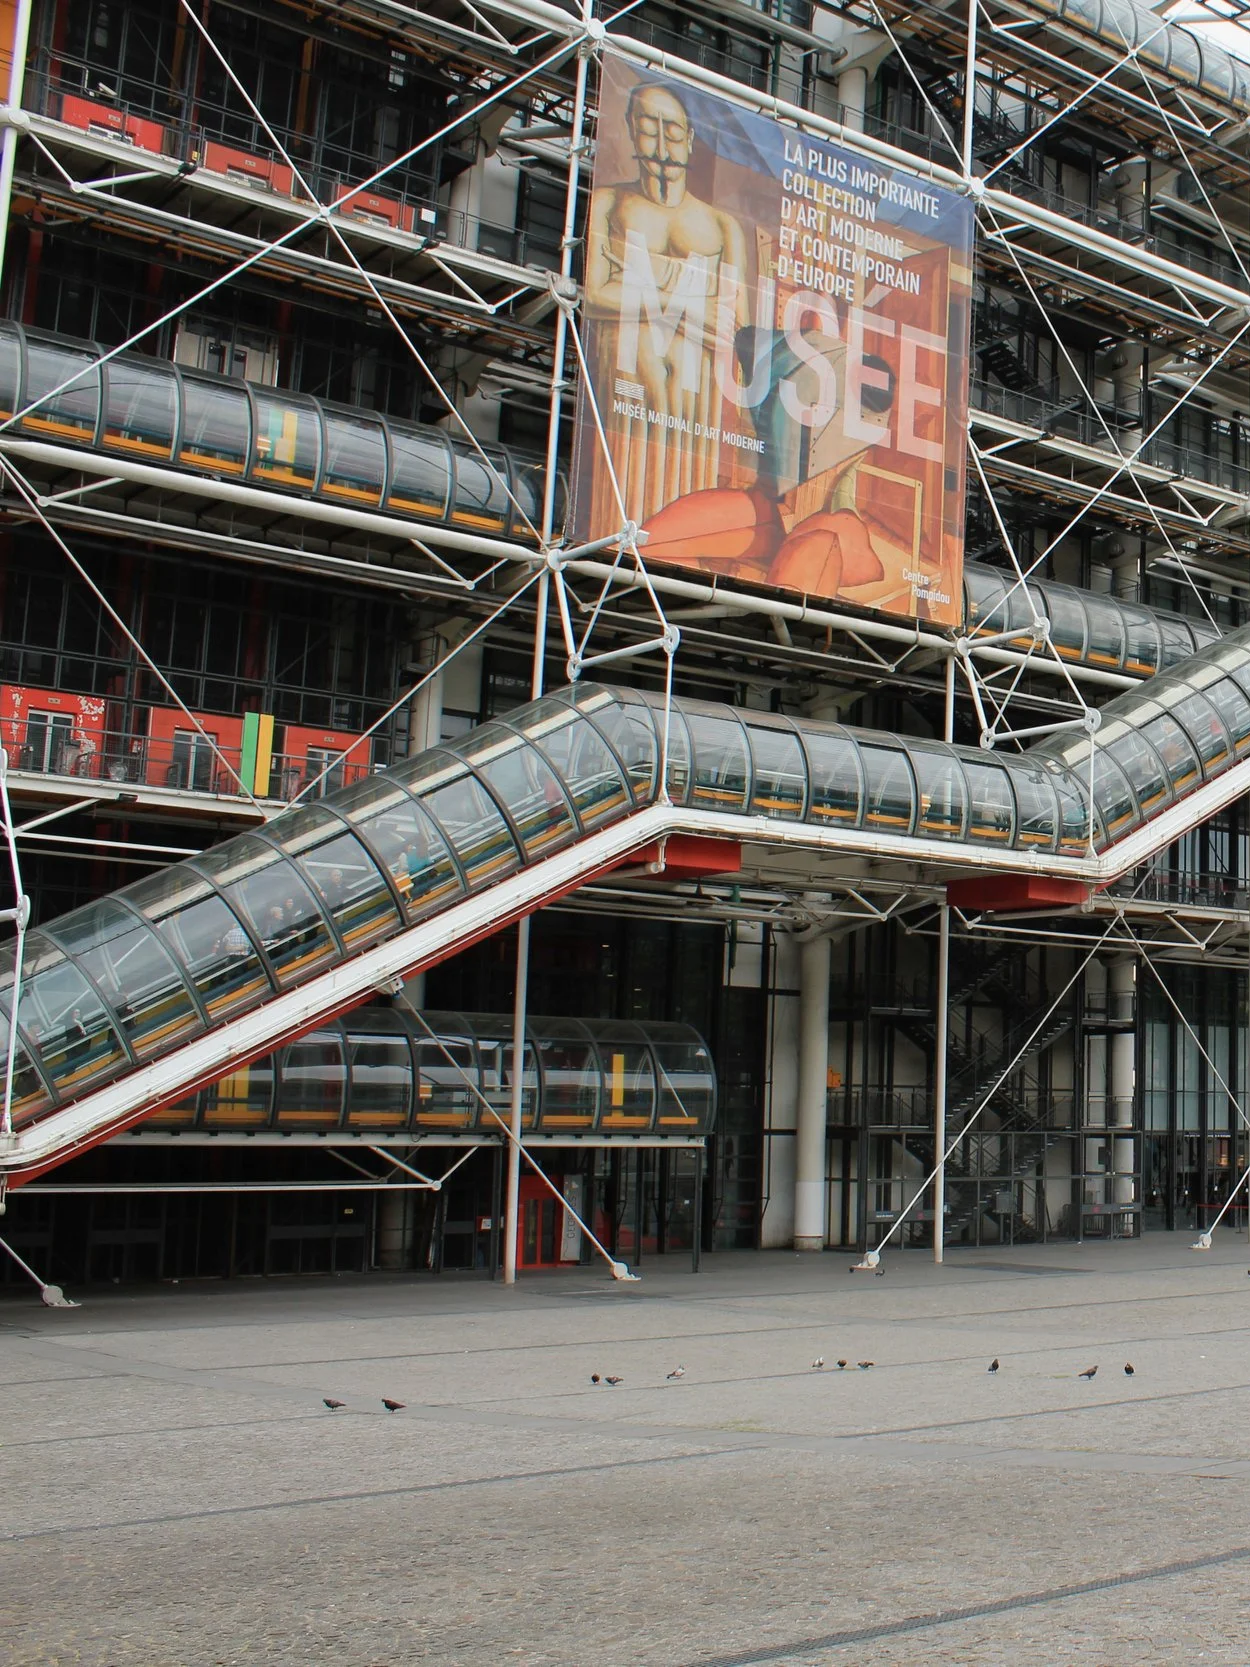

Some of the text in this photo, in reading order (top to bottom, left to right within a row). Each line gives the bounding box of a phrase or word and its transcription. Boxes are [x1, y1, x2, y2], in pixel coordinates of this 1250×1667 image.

[782, 168, 876, 223] COLLECTION
[784, 139, 939, 219] LA PLUS IMPORTANTE
[781, 196, 903, 261] D'ART MODERNE
[777, 254, 855, 302] D'EUROPE
[779, 226, 920, 295] ET CONTEMPORAIN
[616, 229, 949, 462] MUSÉE
[613, 399, 765, 454] MUSÉE NATIONAL D'ART MODERNE
[902, 568, 929, 585] Centre
[911, 584, 950, 605] Pompidou
